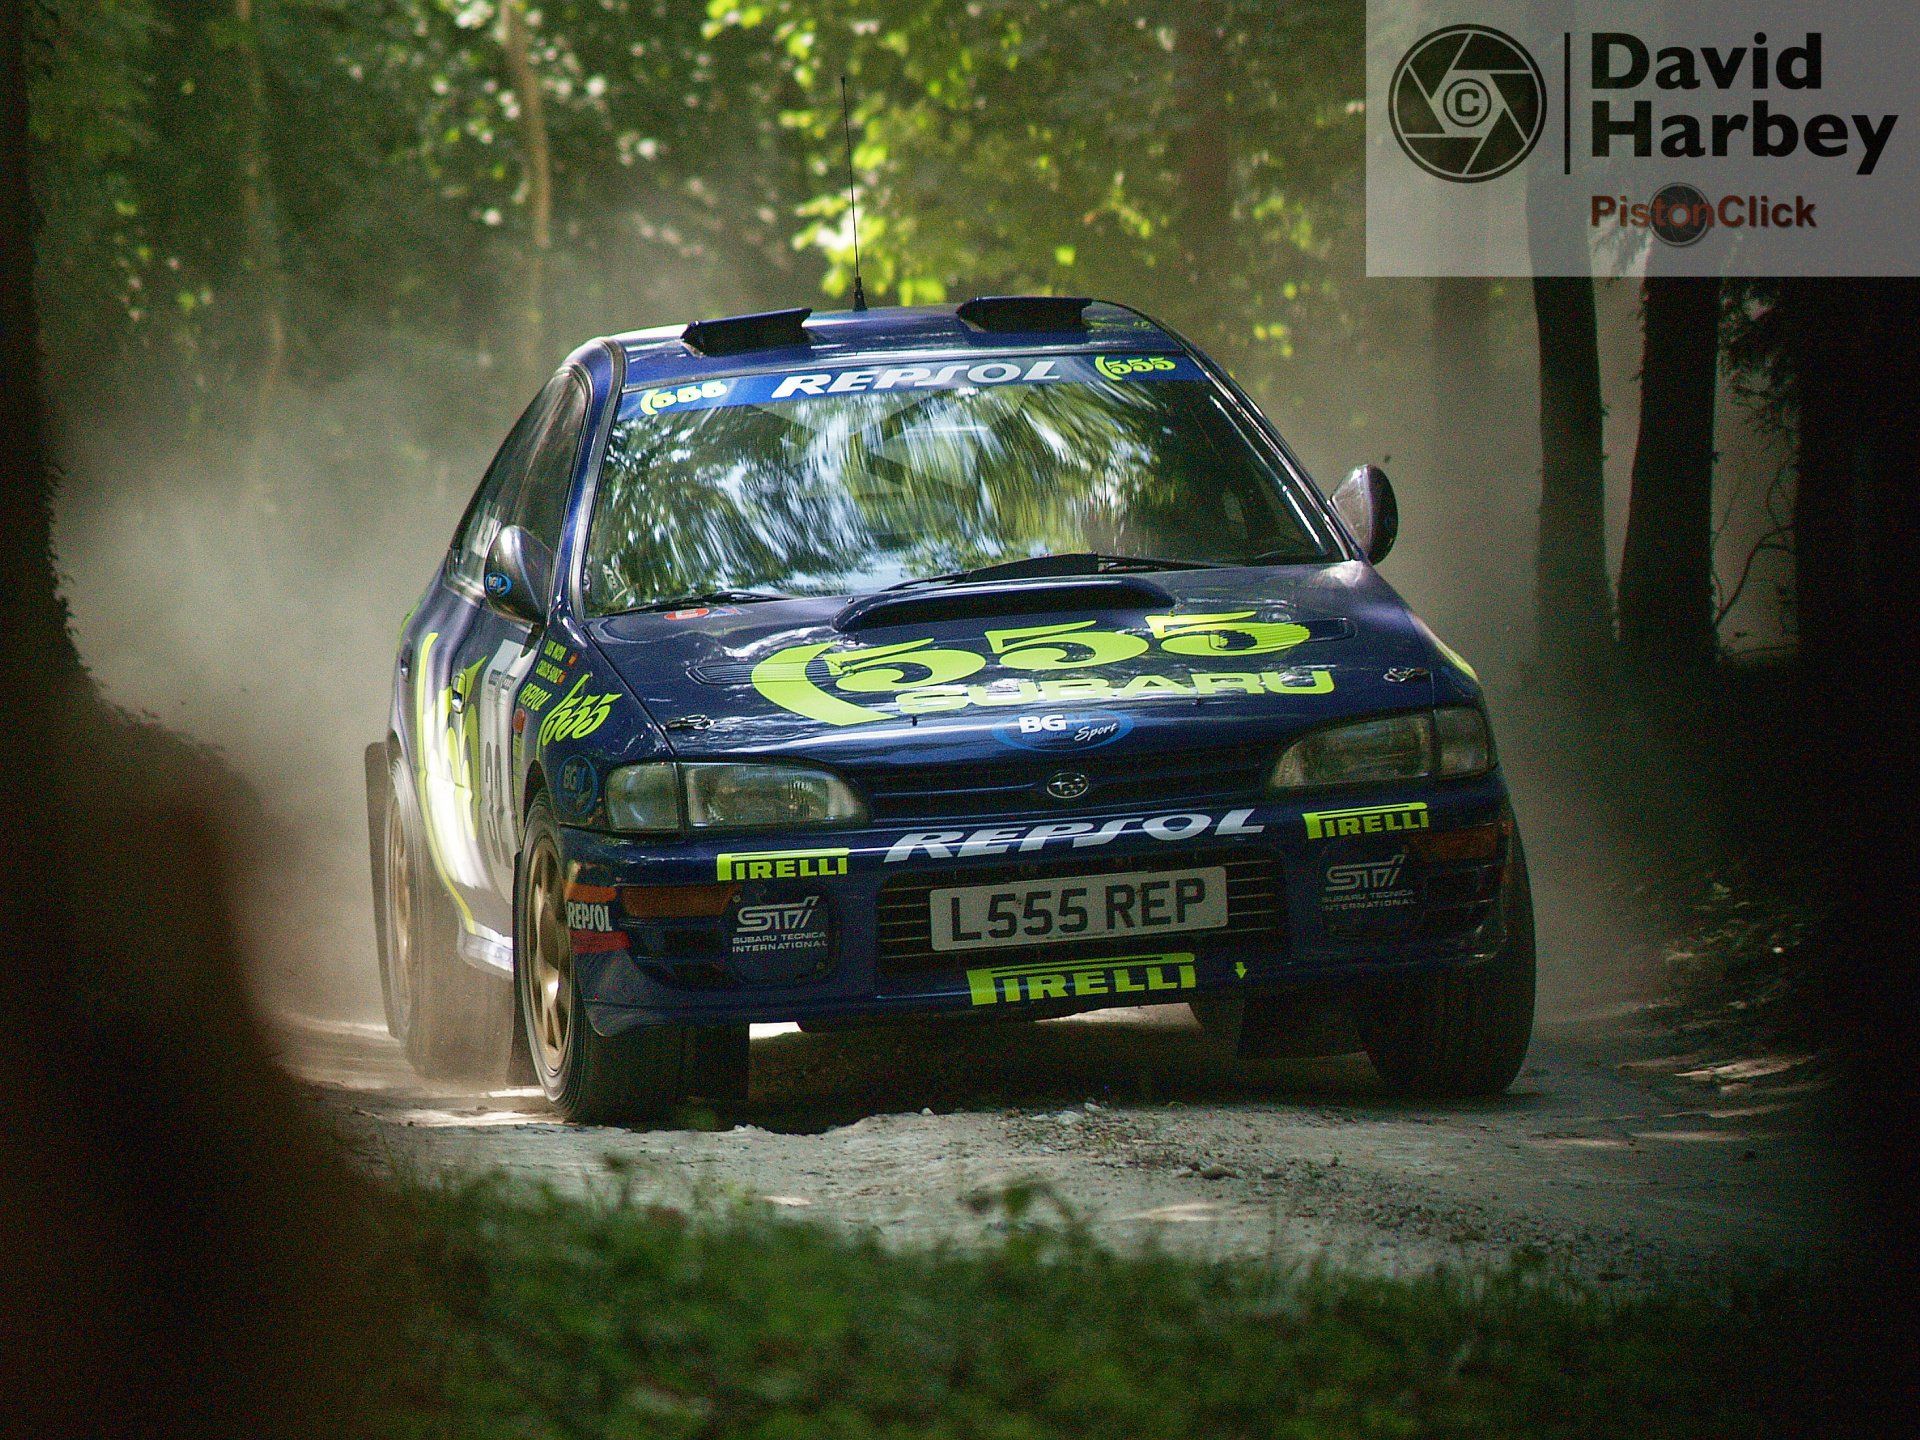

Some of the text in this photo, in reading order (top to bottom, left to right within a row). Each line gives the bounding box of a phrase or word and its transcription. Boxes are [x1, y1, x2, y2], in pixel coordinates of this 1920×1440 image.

[771, 361, 1060, 399] REPSOL
[895, 670, 1334, 713] SUBARU
[1074, 723, 1127, 742] Sport
[884, 809, 1266, 863] REPSOL
[1302, 802, 1429, 839] PIRELLI
[716, 847, 850, 882] PIRELLI
[568, 902, 613, 932] REPSOL
[951, 876, 1206, 943] L555 REP
[732, 930, 827, 945] SUBARU TECNICA
[732, 940, 828, 953] INTERNATIONAL
[966, 951, 1195, 1006] PIRELLI
